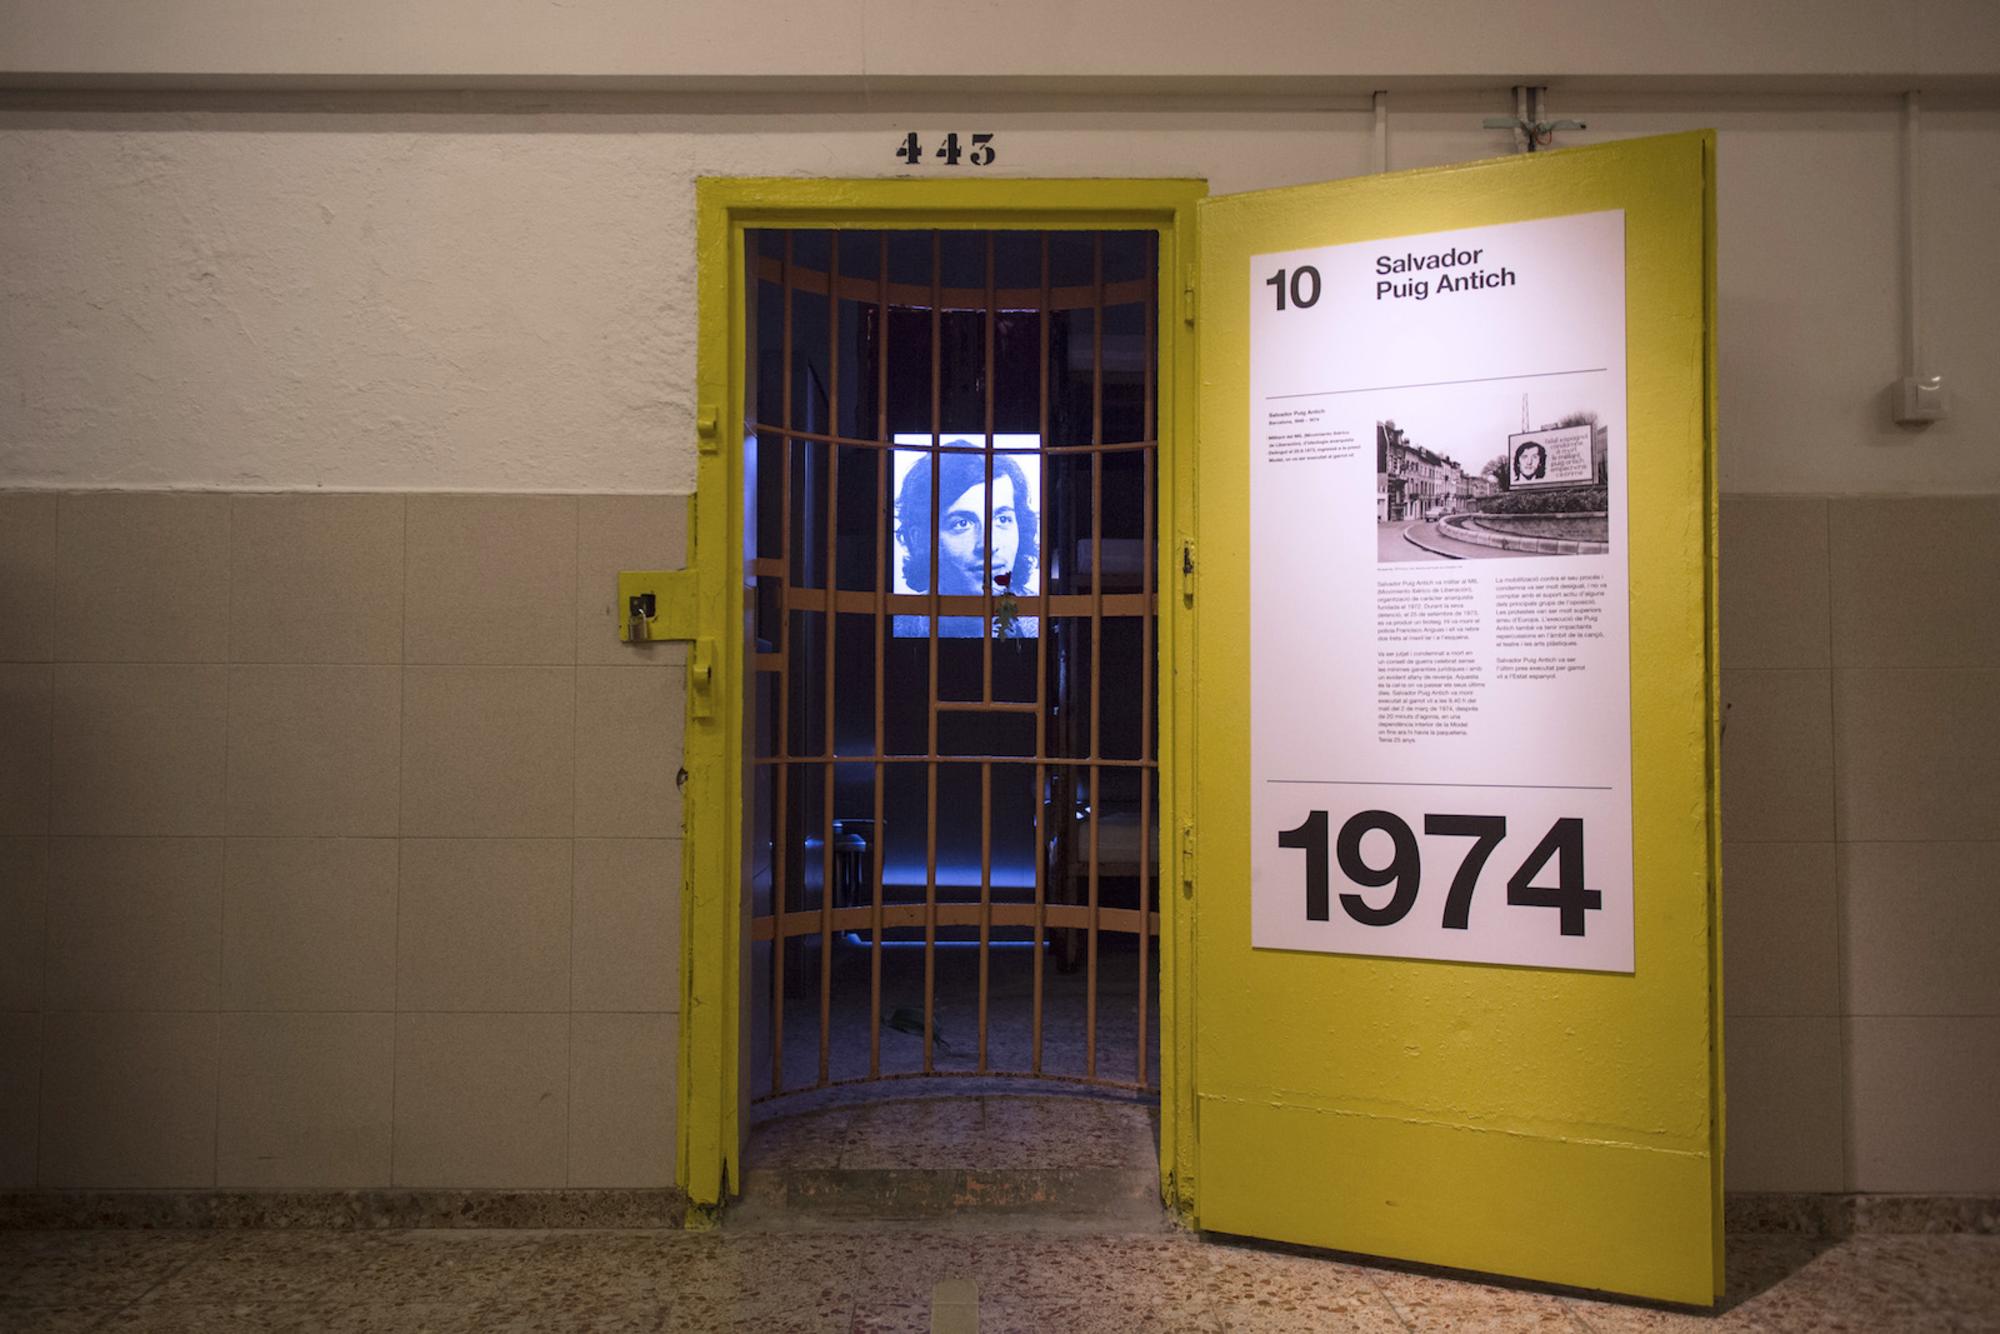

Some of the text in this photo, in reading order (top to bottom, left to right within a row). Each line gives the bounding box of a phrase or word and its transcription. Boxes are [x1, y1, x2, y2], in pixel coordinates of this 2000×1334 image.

[896, 132, 995, 166] 443
[1375, 248, 1483, 275] Salvador
[1266, 265, 1321, 311] 10
[1376, 267, 1516, 300] Puig Antich
[1278, 810, 1602, 937] 1974
